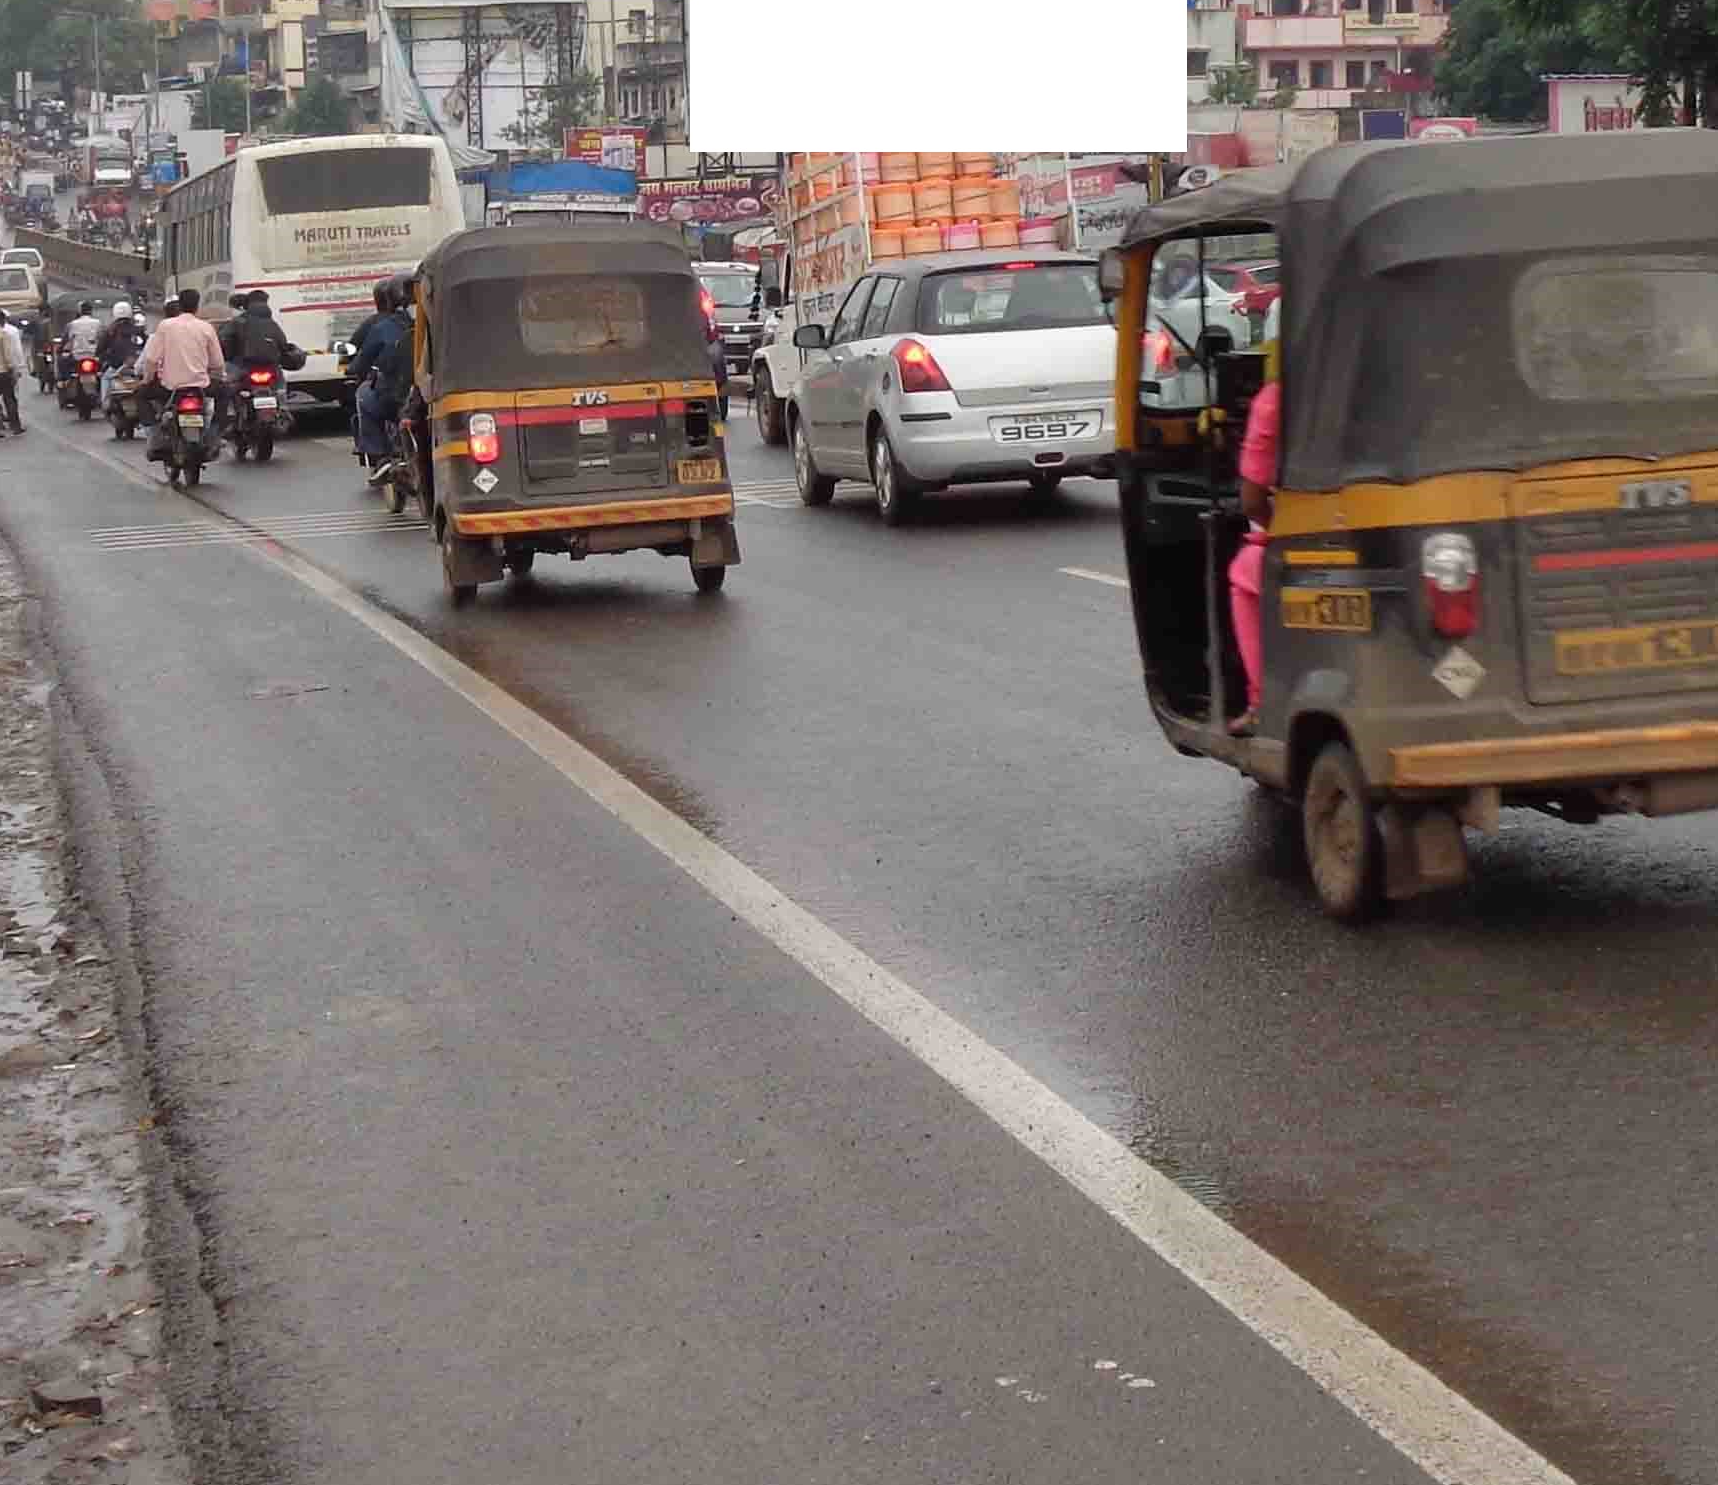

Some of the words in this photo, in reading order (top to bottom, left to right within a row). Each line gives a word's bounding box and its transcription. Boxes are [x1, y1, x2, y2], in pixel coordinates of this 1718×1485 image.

[294, 226, 351, 242] MARUTI
[357, 224, 411, 239] TRAVELS
[572, 390, 608, 406] TVS
[1001, 422, 1090, 441] 9697
[1619, 481, 1692, 508] TVS
